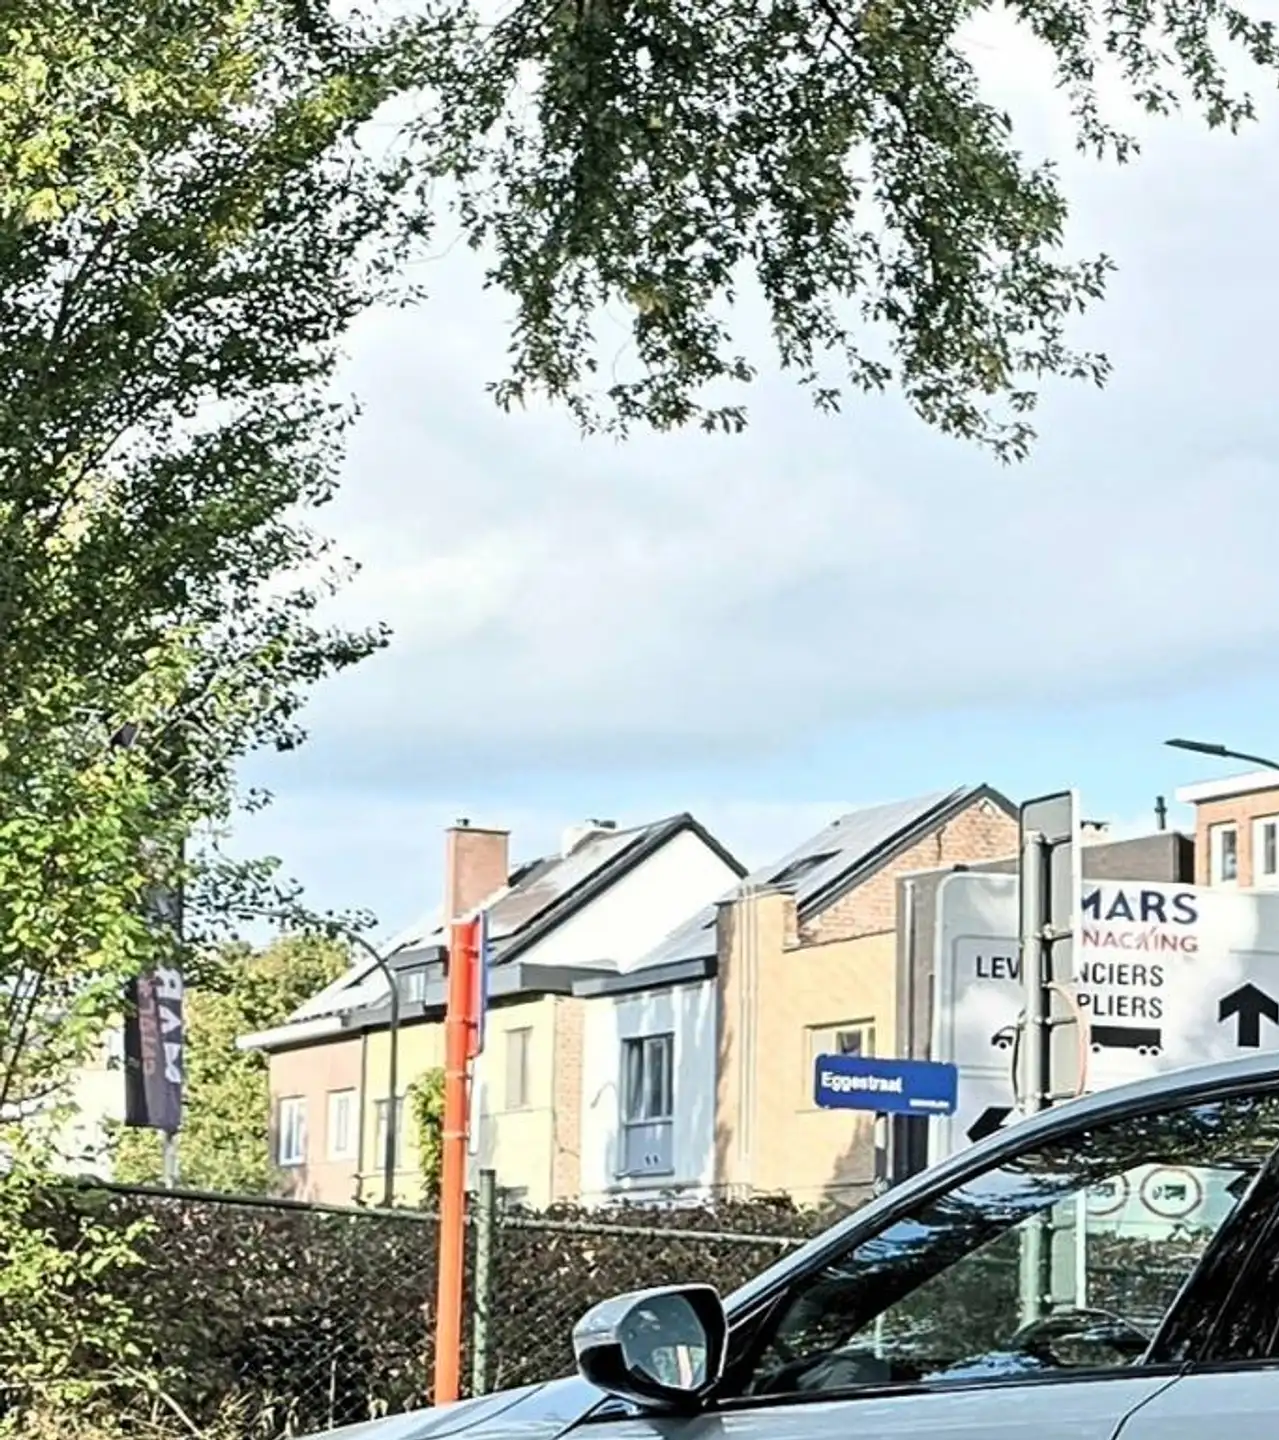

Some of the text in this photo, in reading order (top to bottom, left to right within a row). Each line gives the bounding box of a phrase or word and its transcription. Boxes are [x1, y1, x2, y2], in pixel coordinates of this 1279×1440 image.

[1080, 888, 1198, 925] MARS
[1082, 926, 1198, 953] NACKING
[1076, 993, 1163, 1020] PLIERS
